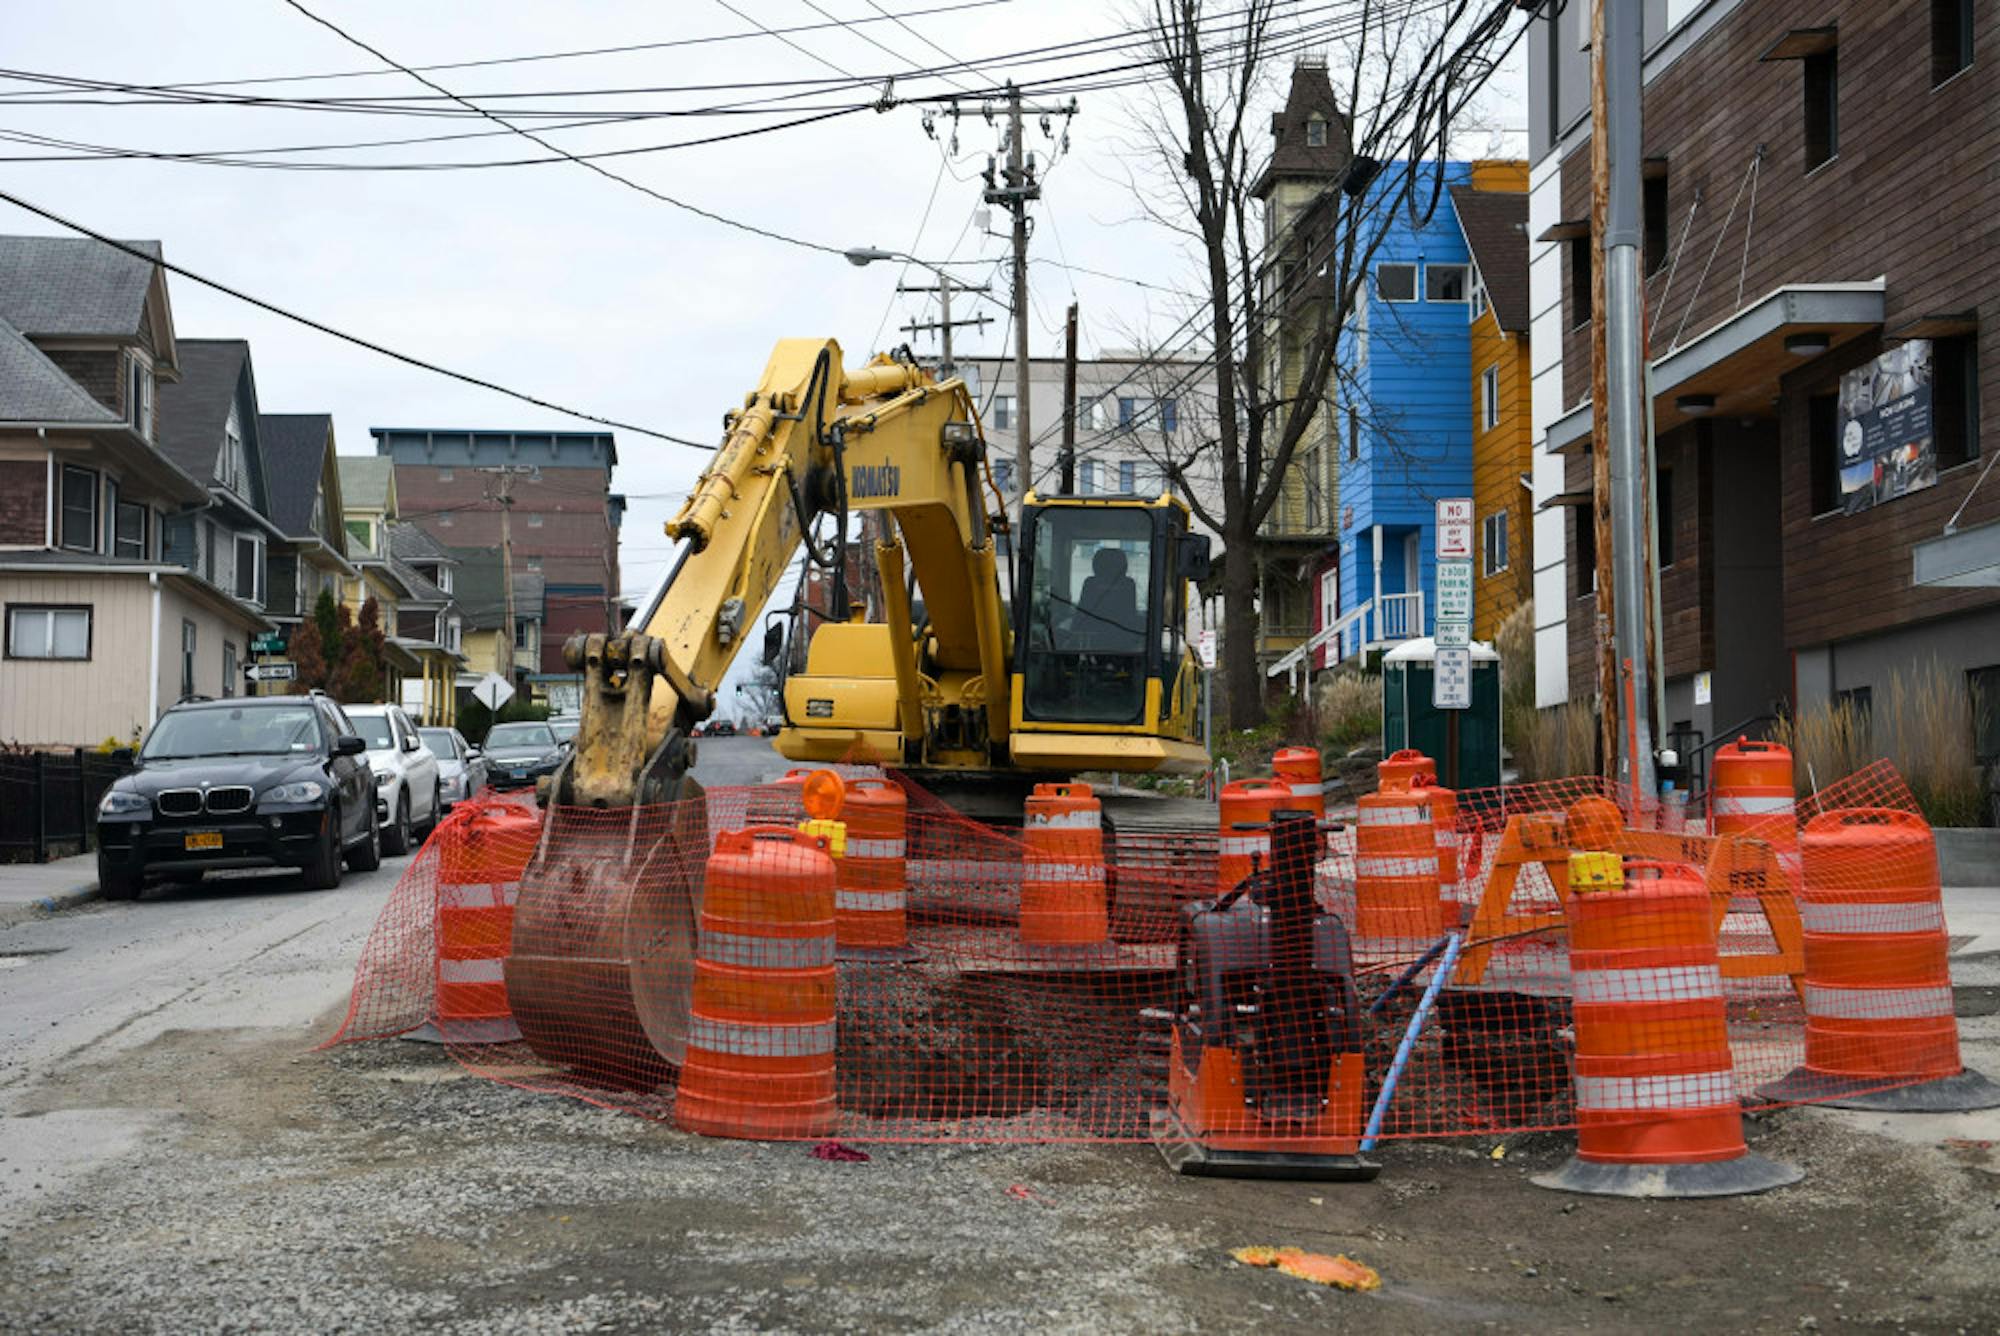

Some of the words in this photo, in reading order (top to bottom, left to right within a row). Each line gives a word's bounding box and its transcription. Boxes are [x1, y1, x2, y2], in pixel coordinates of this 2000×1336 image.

[851, 456, 900, 498] KOMATSU
[1447, 505, 1463, 516] NO
[1448, 567, 1467, 576] HOUR
[1439, 578, 1469, 588] PARKING
